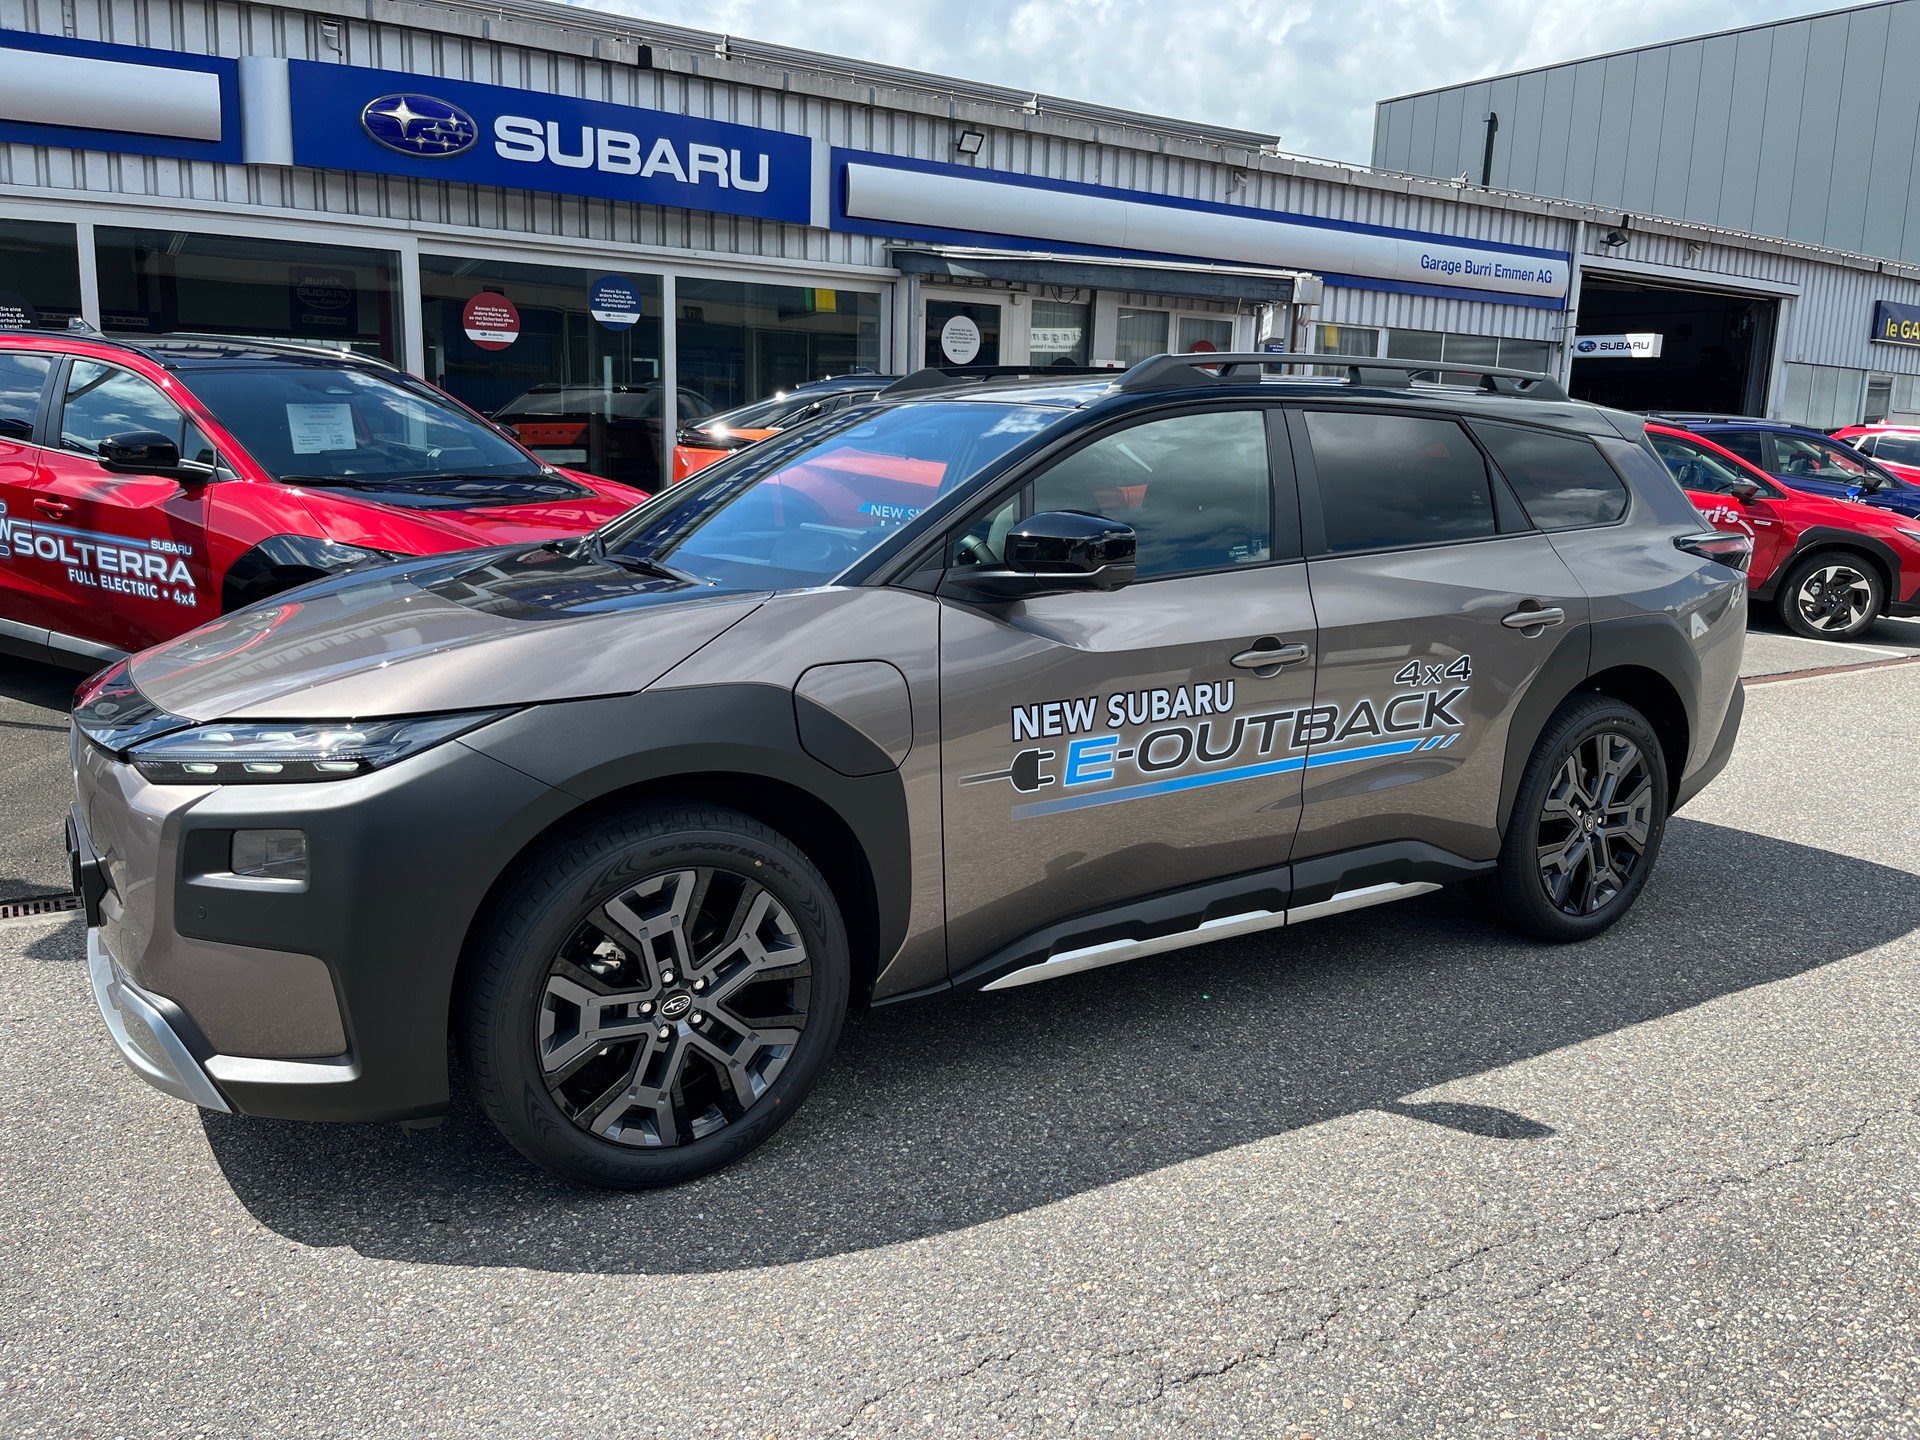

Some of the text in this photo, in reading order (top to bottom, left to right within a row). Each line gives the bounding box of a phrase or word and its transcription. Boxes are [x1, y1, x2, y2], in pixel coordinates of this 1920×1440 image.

[494, 115, 769, 193] SUBARU
[1420, 254, 1553, 284] Garage Burri Emmen AG
[1886, 317, 1898, 338] le
[1600, 341, 1650, 351] SUBARU
[870, 504, 904, 519] NEW
[13, 531, 196, 588] SOLTERRA
[150, 540, 192, 556] SUBARU
[68, 568, 197, 607] FULL ELECTRIC 4x4
[1394, 655, 1472, 687] 4x4
[1012, 680, 1235, 742] NEW SUBARU
[1063, 686, 1469, 786] E-OUTBACK
